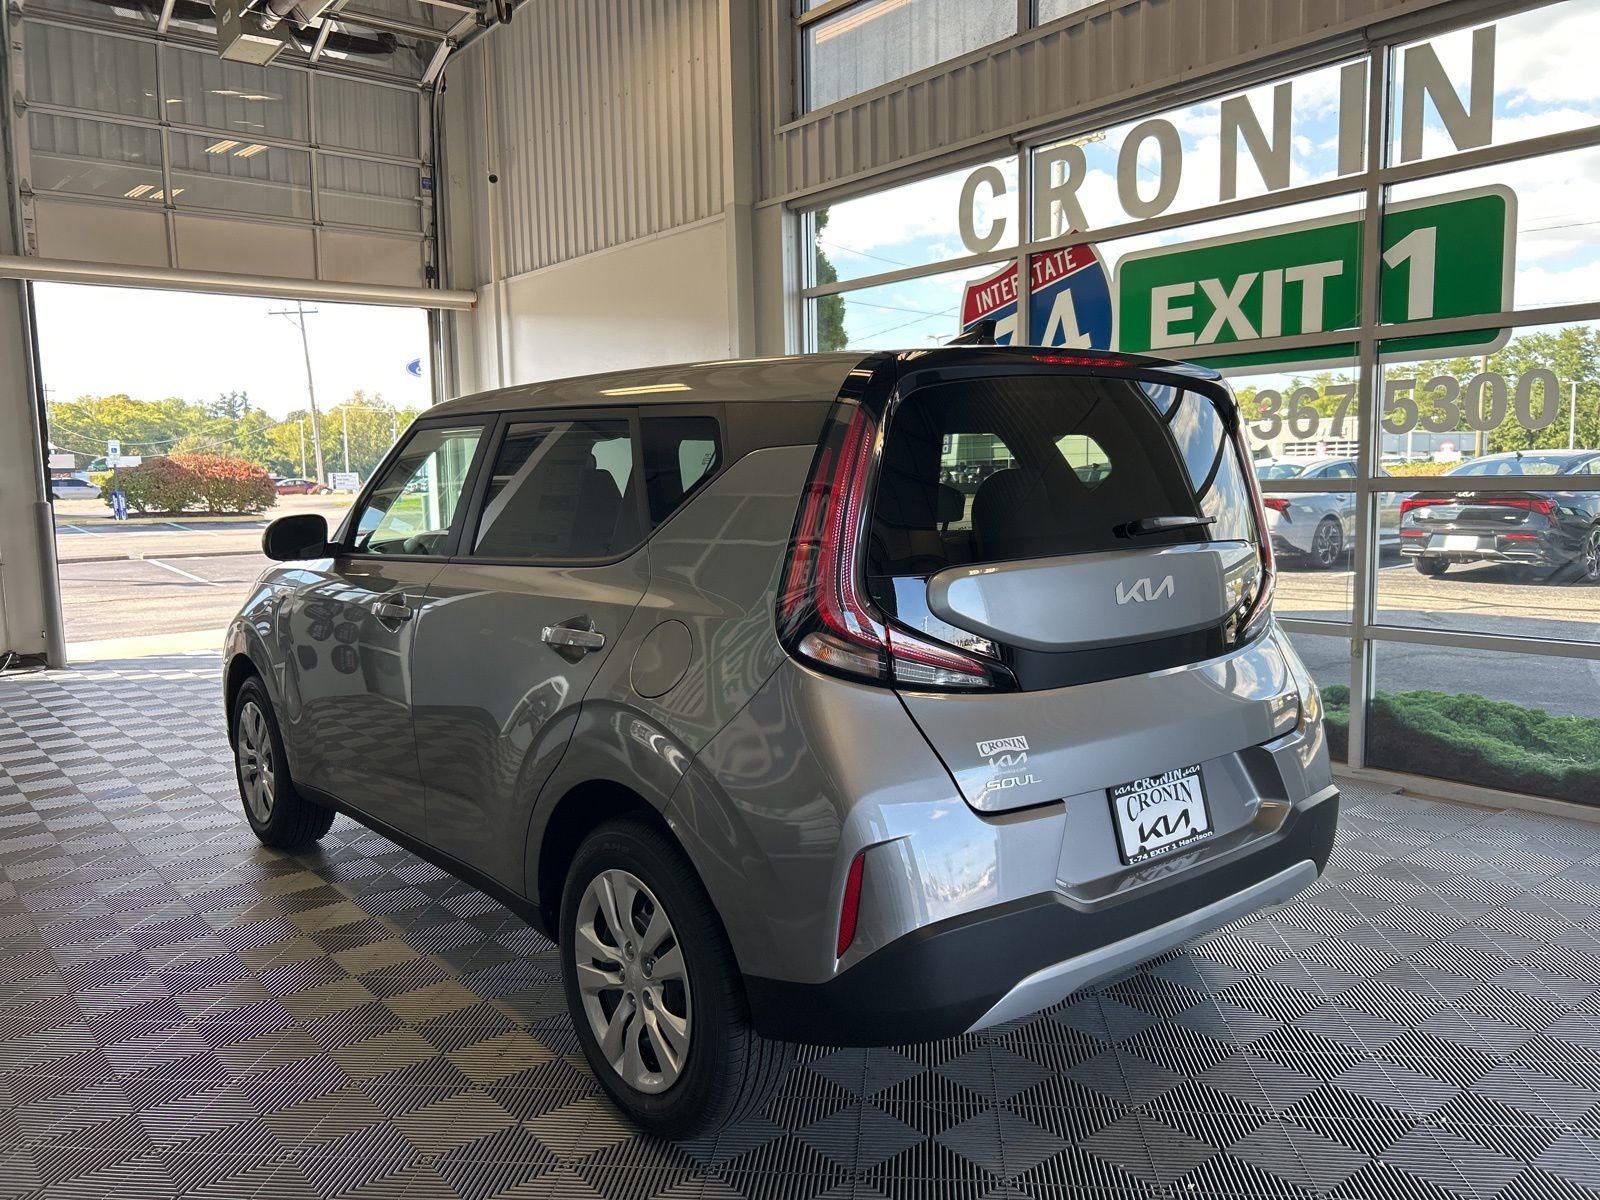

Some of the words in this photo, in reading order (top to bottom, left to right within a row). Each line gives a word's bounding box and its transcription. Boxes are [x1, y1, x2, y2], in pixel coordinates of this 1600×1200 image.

[958, 25, 1496, 254] CRONIN
[975, 246, 1077, 314] INTERTATE
[1150, 259, 1344, 349] EXIT
[1382, 226, 1437, 320] 1
[1380, 369, 1559, 434] 5300
[1115, 575, 1175, 605] KIA
[979, 737, 1027, 755] CRONIN
[988, 752, 1028, 768] KIA
[986, 774, 1042, 791] SOUL
[1126, 780, 1193, 822] CRONIN
[1138, 808, 1191, 844] KIA
[1128, 853, 1149, 865] I-74
[1150, 845, 1170, 858] EXIT
[1179, 831, 1213, 847] Harrison
